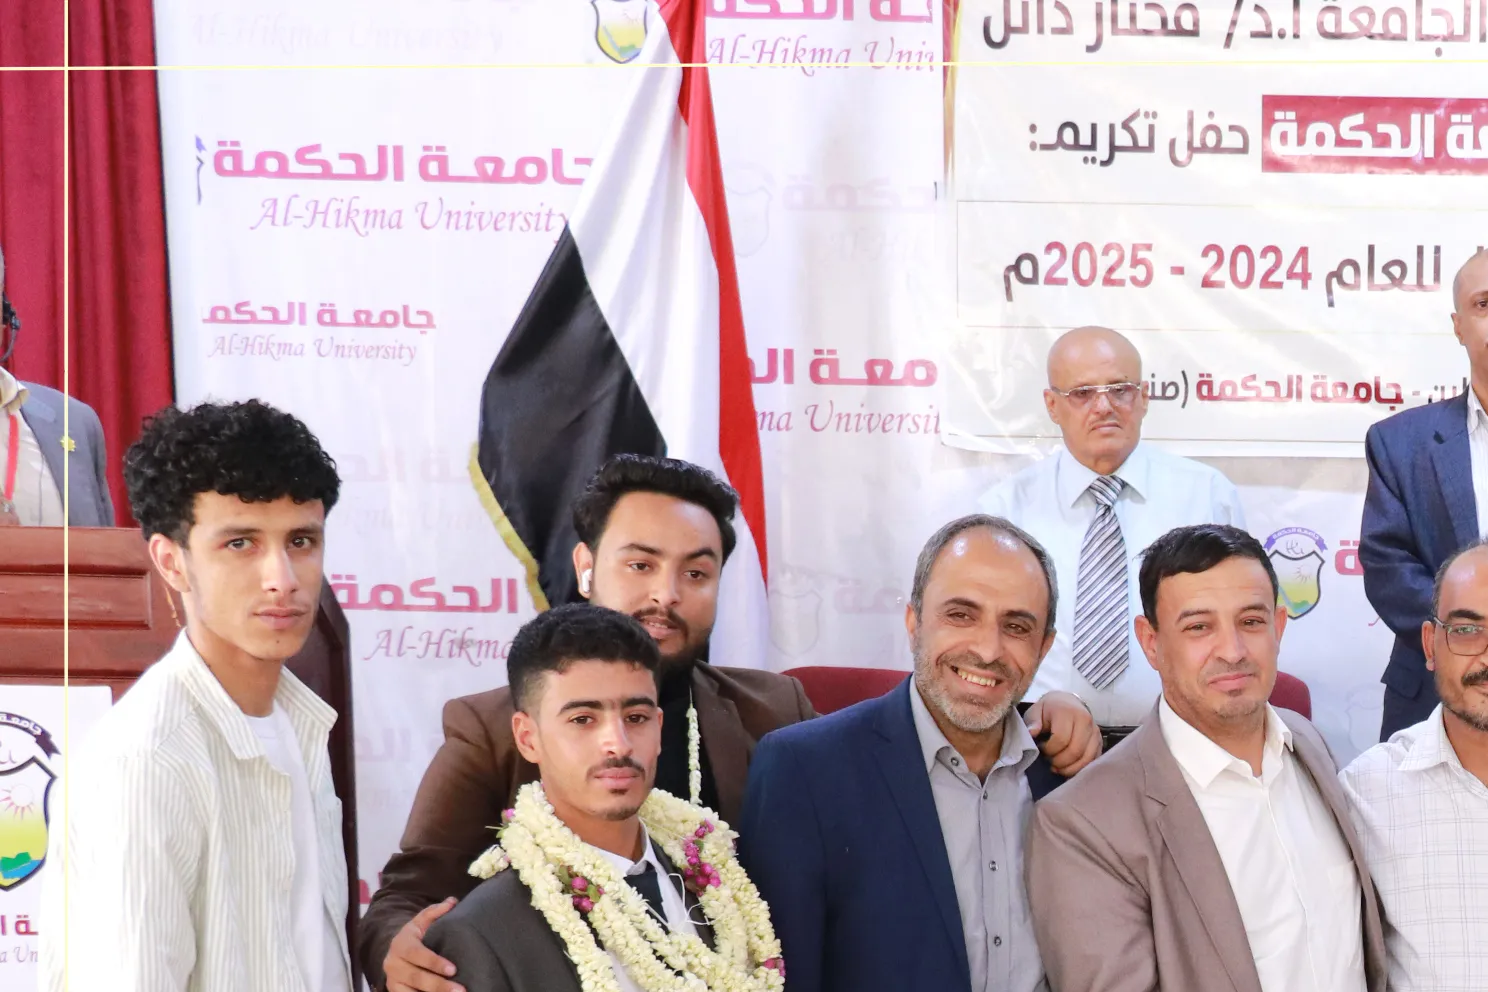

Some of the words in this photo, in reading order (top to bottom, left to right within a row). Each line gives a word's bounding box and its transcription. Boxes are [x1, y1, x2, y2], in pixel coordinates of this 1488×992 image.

[708, 33, 852, 77] Al-Hikma
[1169, 109, 1249, 167] حفل
[1270, 111, 1434, 158] الحكمة
[213, 140, 404, 182] الحكمة
[249, 194, 404, 237] Al-Hikma
[1201, 243, 1312, 290] 2024
[1325, 244, 1441, 308] للعام
[317, 303, 437, 334] جامعة
[207, 333, 306, 361] Al-Hikma
[313, 336, 417, 367] University
[1195, 373, 1303, 403] الحكمة
[1310, 375, 1404, 411] جامعة
[330, 574, 519, 614] الحكمة
